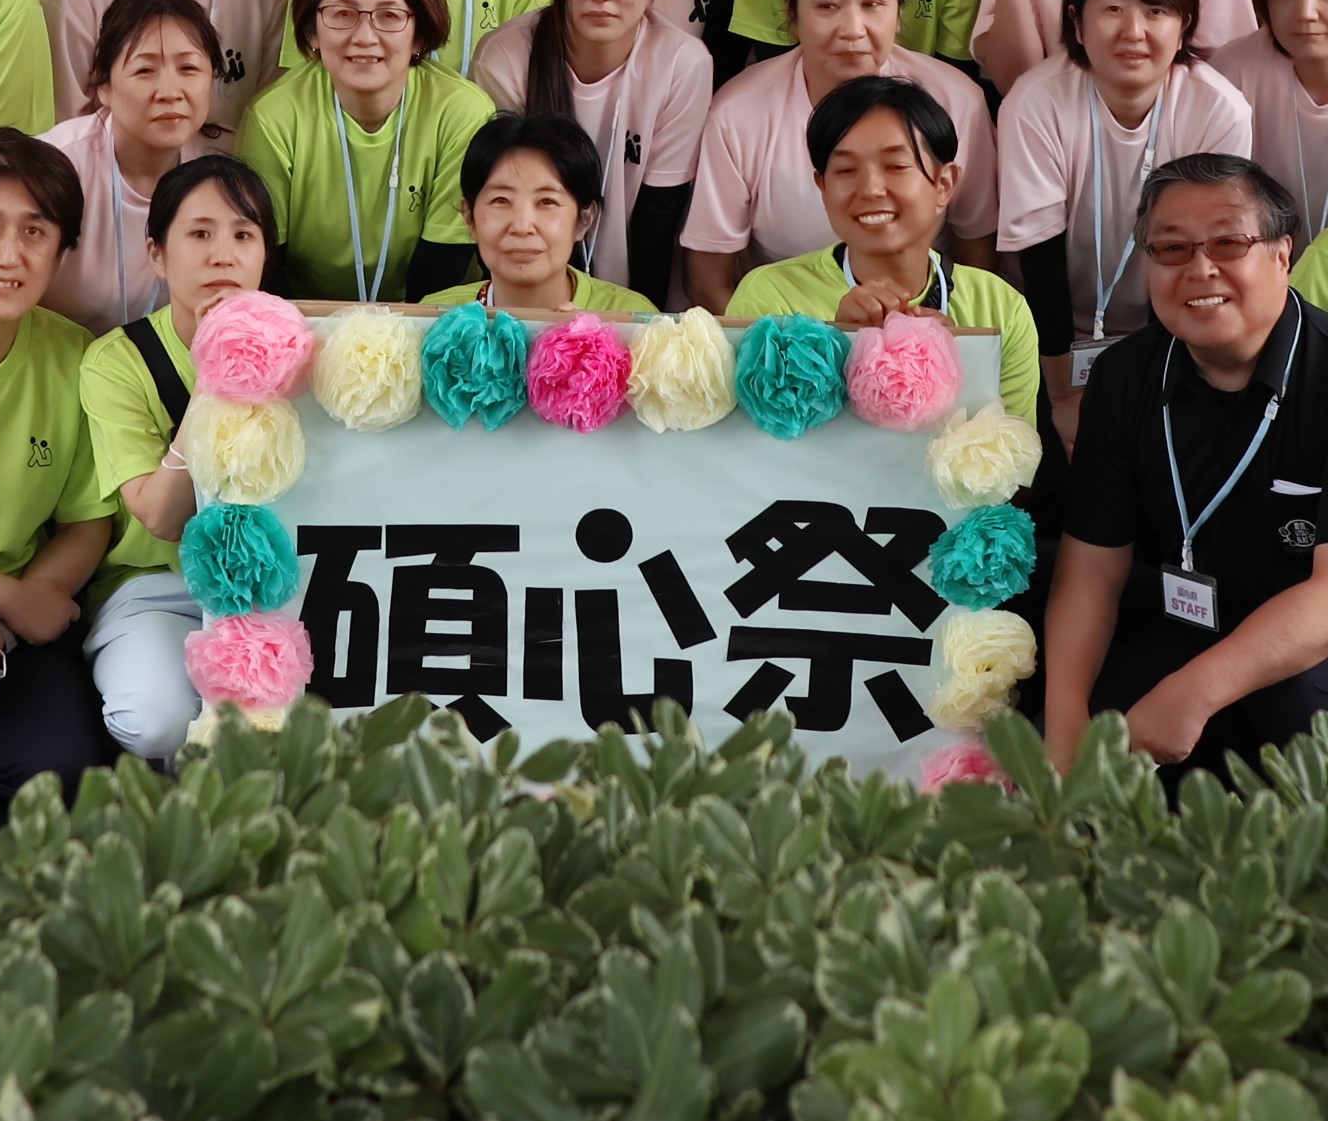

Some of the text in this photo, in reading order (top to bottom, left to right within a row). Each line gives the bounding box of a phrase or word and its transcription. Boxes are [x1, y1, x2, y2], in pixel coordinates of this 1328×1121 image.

[297, 500, 950, 744] 碩心祭
[1171, 597, 1208, 619] STAFF
